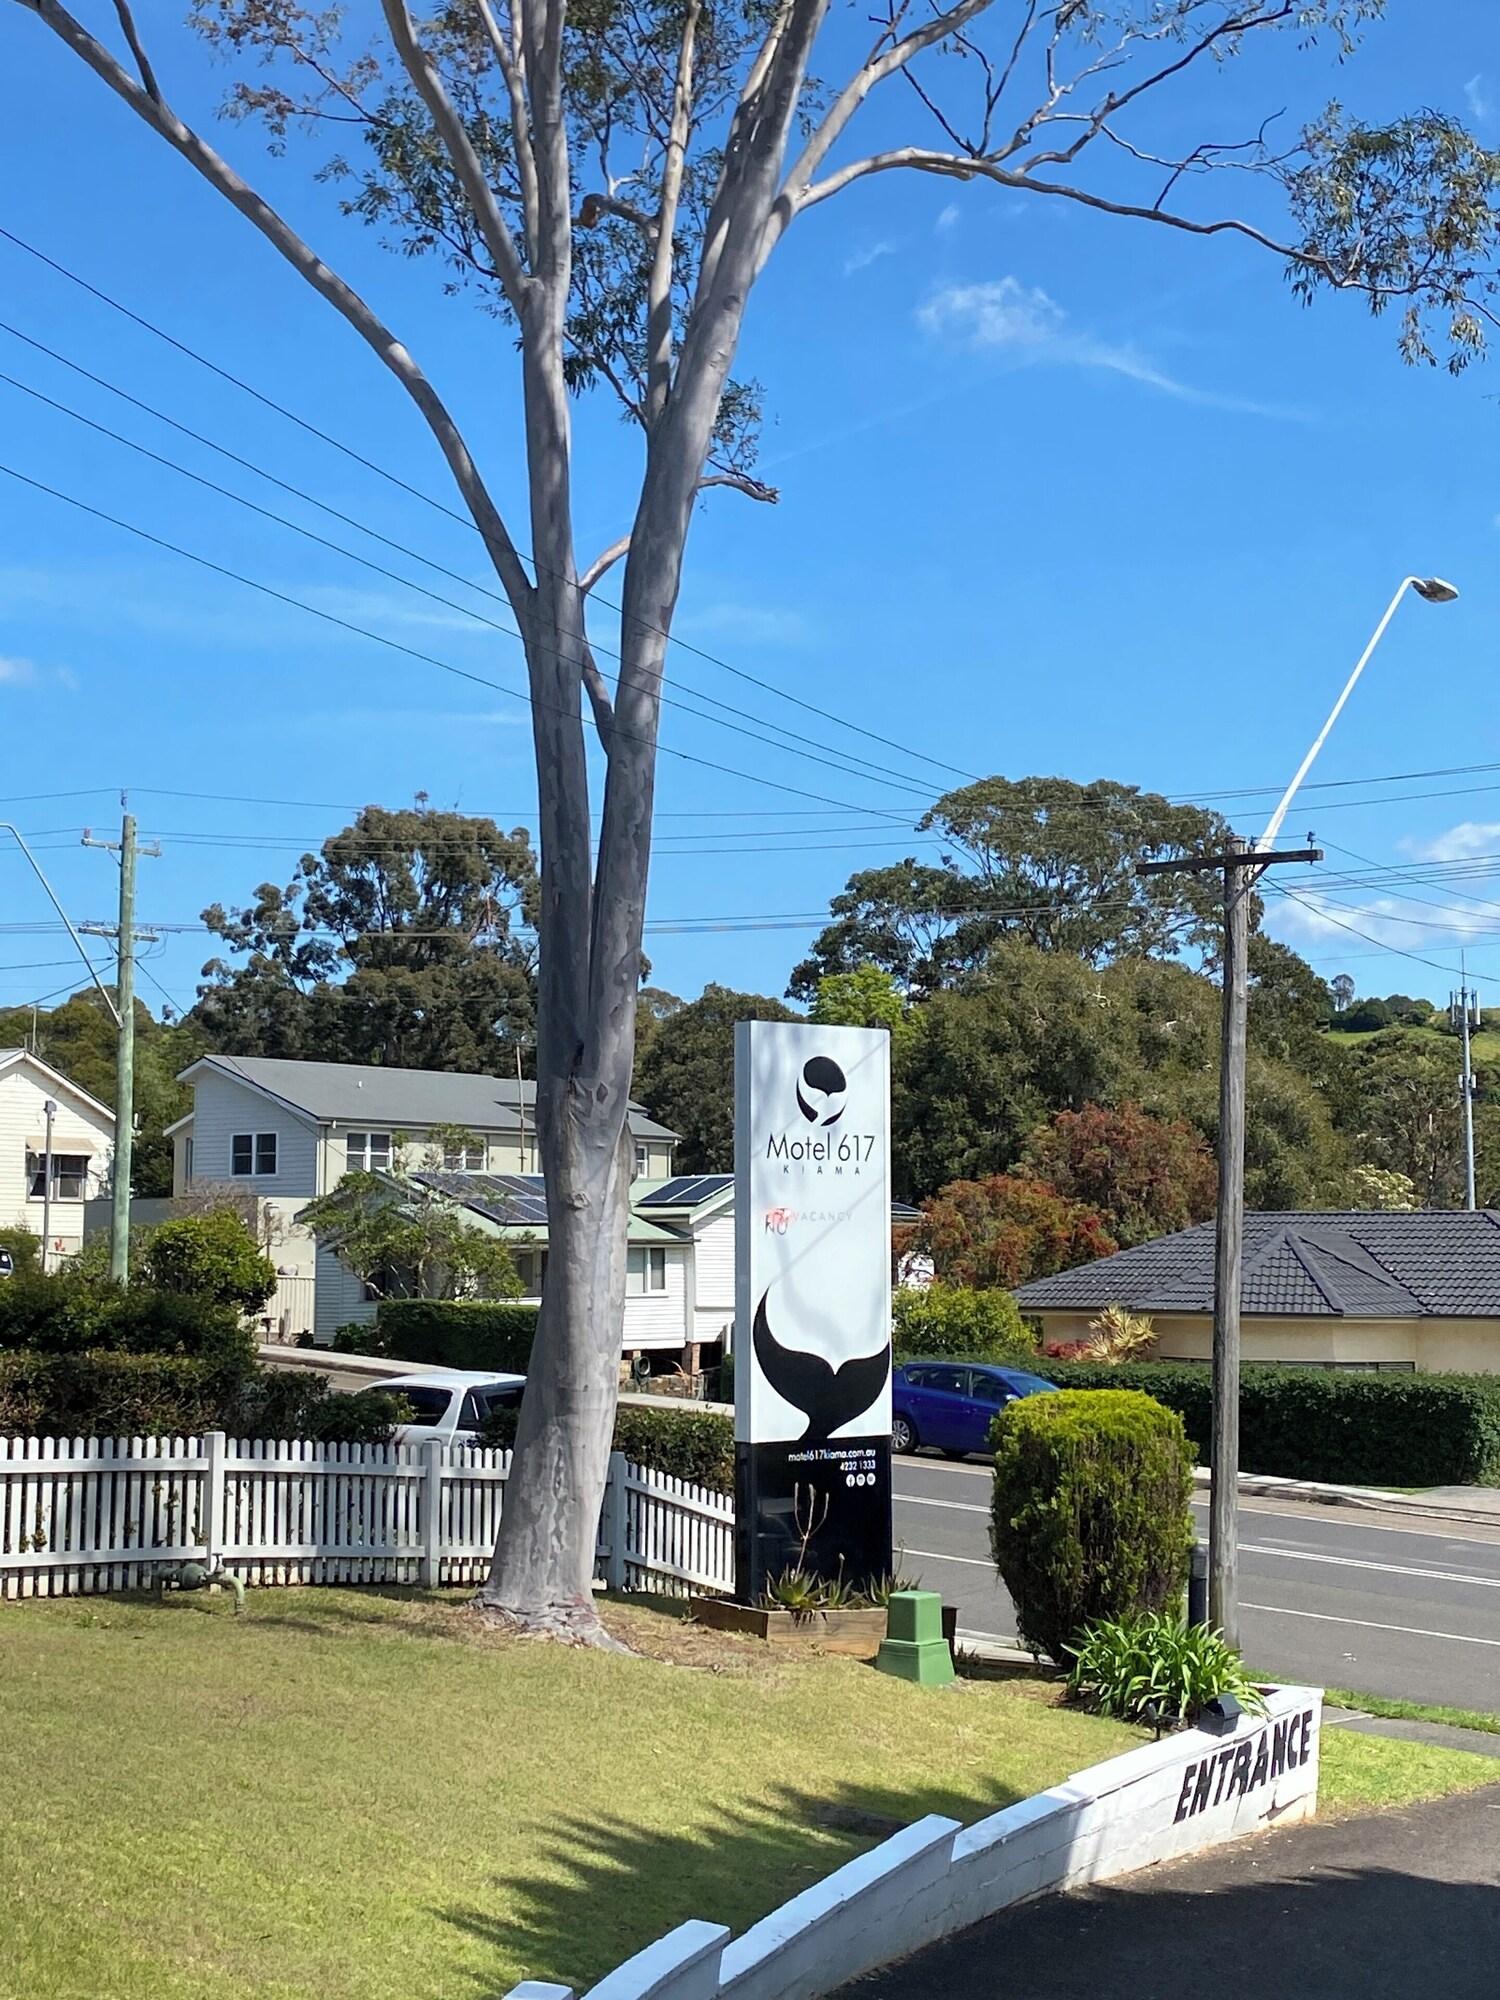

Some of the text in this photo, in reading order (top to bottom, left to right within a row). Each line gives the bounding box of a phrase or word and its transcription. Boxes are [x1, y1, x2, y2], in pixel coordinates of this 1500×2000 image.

[766, 1132, 876, 1162] Motel 617
[783, 1165, 860, 1176] KIAMA
[793, 1210, 852, 1222] VACANCY
[788, 1449, 876, 1462] motel617kiama.com.au
[840, 1460, 876, 1471] 4232 1333
[1172, 1709, 1314, 1825] ENTRANCE
